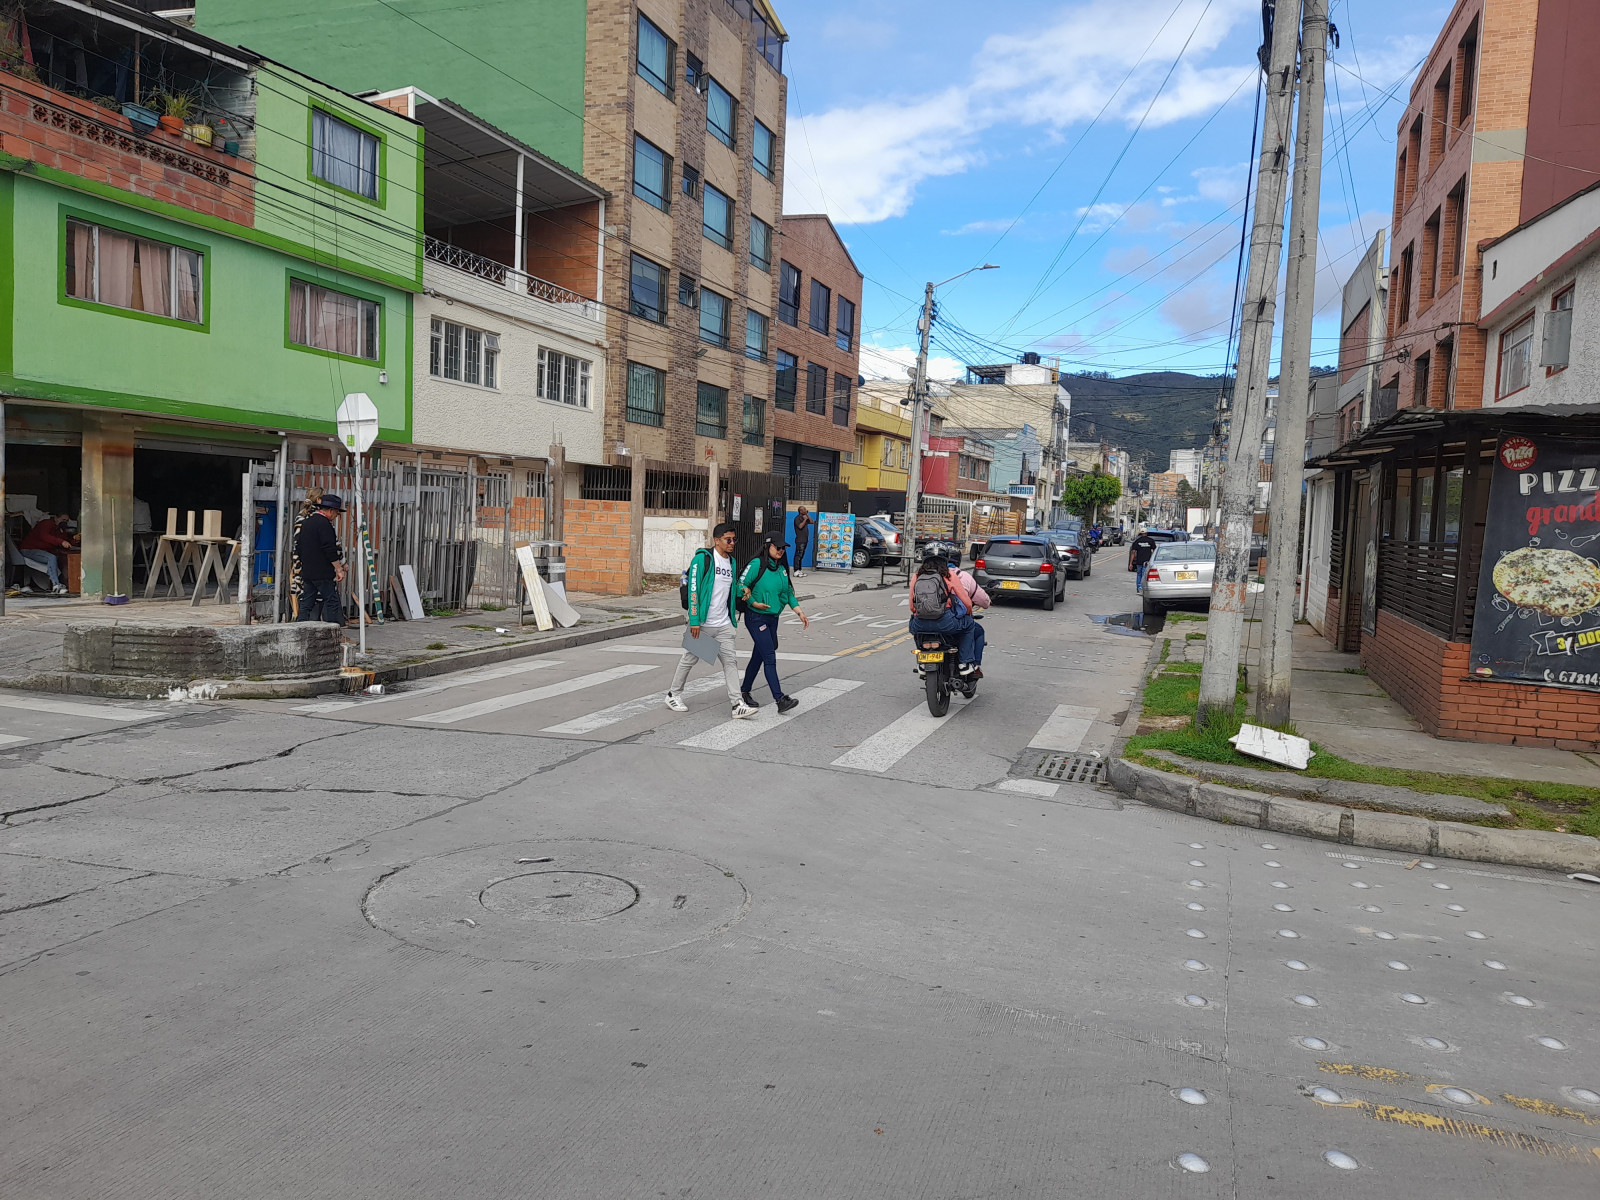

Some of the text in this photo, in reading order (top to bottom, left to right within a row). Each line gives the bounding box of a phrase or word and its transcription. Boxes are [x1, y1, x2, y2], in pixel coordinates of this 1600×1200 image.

[1502, 445, 1535, 464] PIZZA
[1519, 467, 1600, 496] PIZZ
[1558, 670, 1600, 686] 67814
